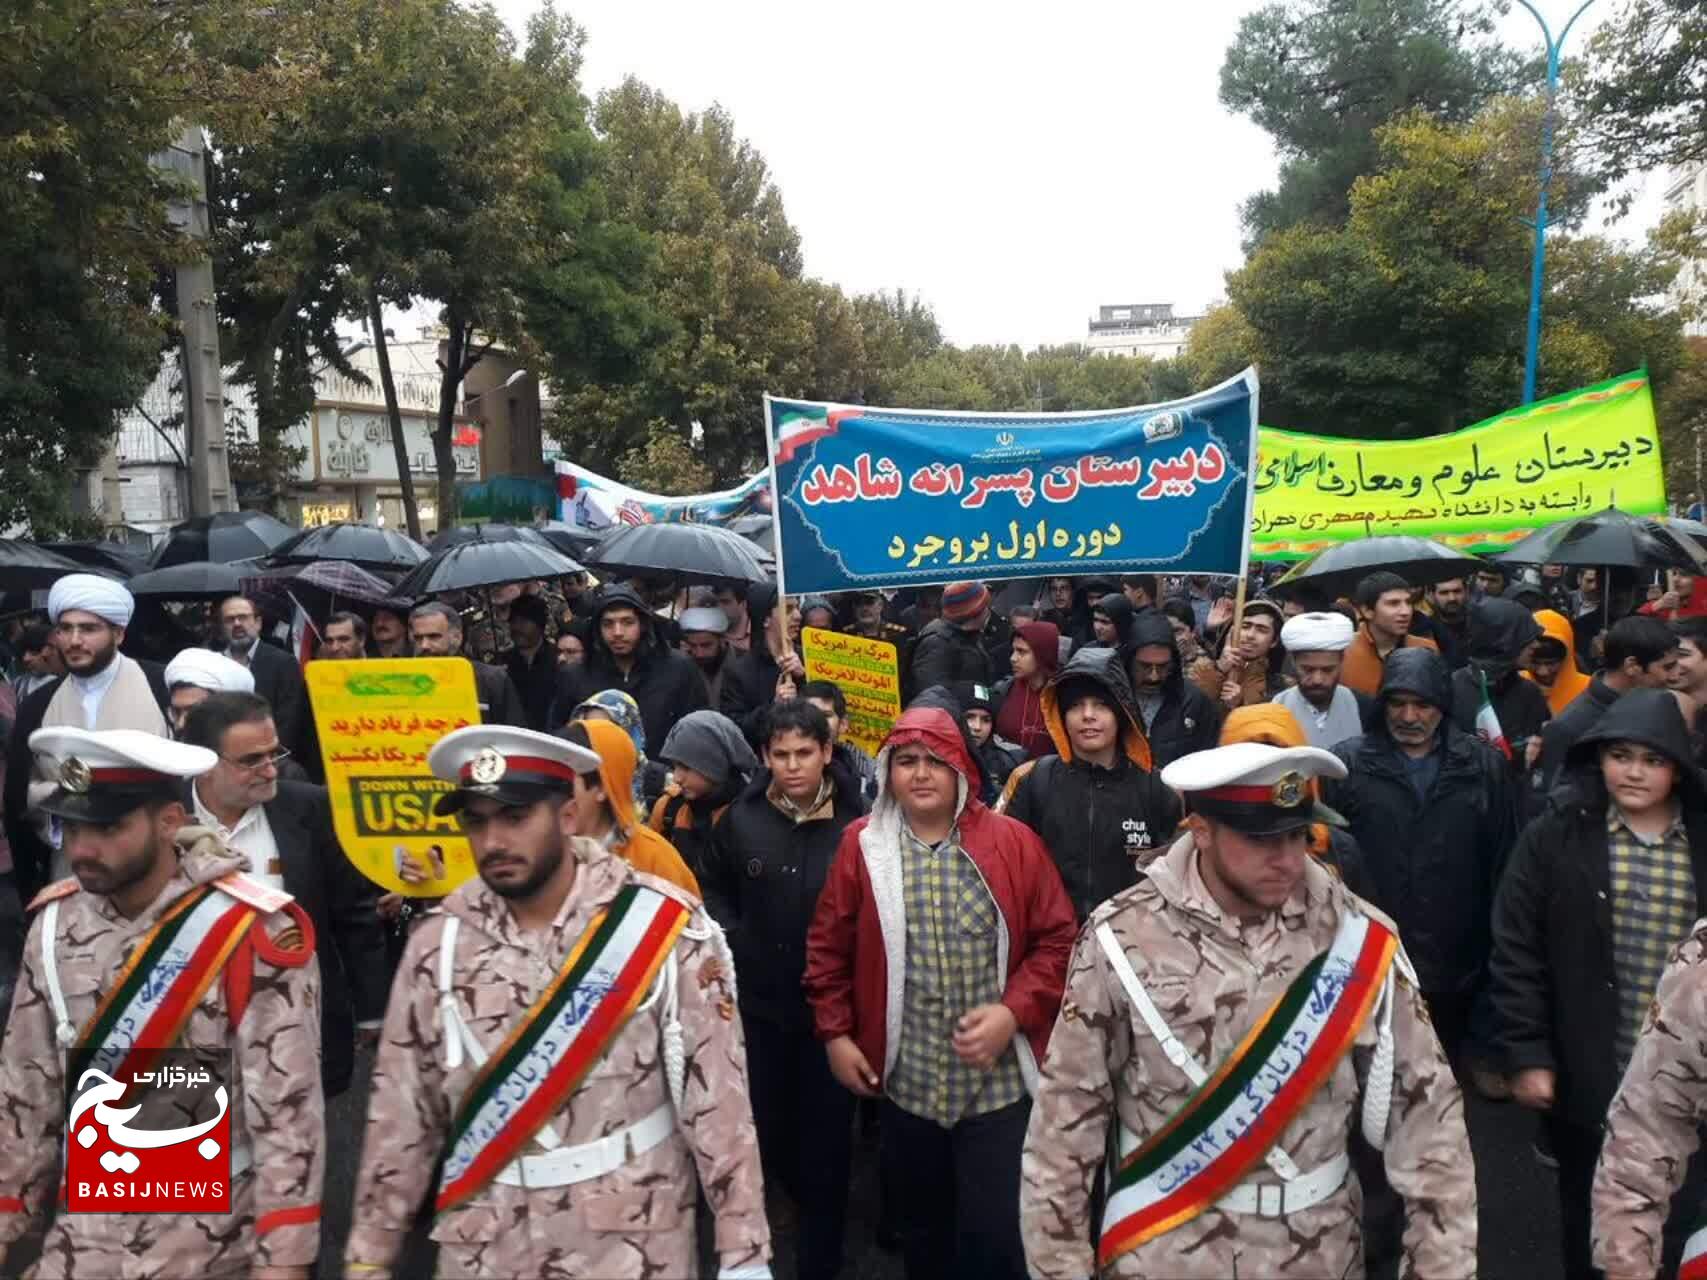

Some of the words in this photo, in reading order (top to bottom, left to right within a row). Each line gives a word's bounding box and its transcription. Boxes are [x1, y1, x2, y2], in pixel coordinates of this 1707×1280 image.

[1041, 442, 1225, 502] دبیرستان
[1432, 443, 1500, 505] علوم
[1515, 431, 1653, 483] دبیرستان
[801, 453, 903, 506] شاهد
[909, 462, 1035, 508] پسرانه
[888, 531, 990, 568] بروجرد
[997, 520, 1046, 560] اول
[1053, 523, 1122, 557] دوره
[359, 780, 409, 792] DOWN
[412, 779, 457, 792] WITH
[361, 793, 461, 832] USA
